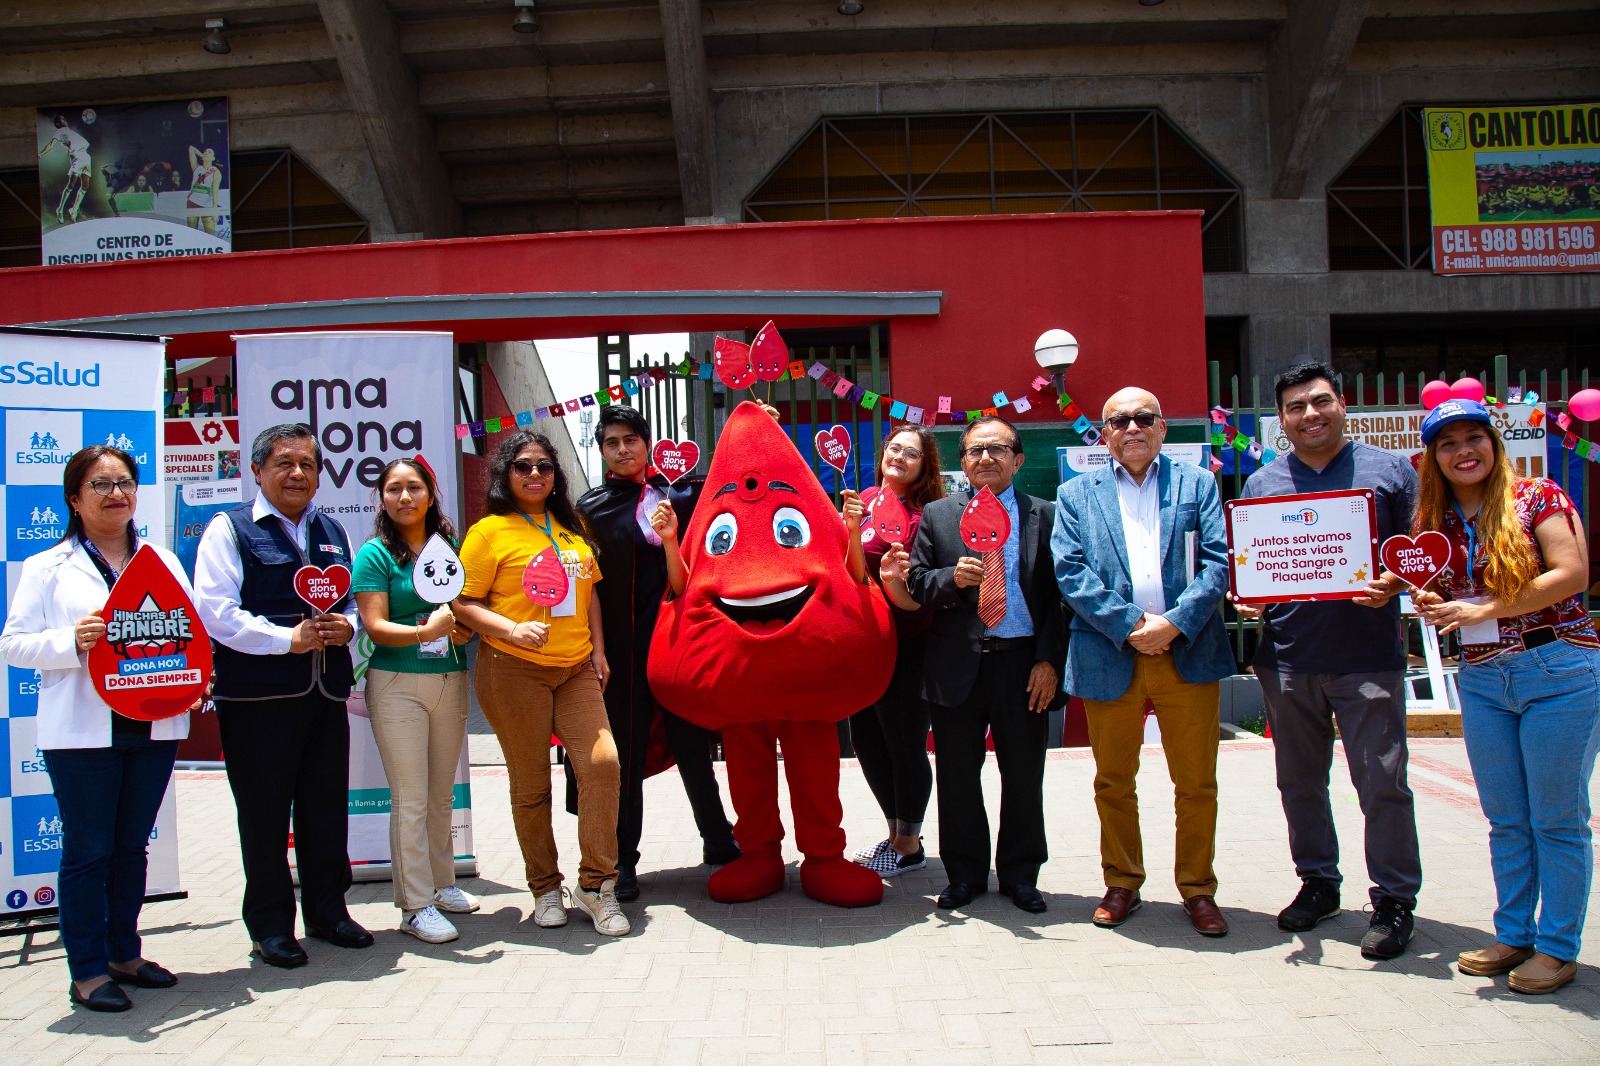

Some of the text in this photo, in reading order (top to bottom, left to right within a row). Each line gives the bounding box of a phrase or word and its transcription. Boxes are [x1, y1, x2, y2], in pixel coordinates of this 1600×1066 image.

[1468, 107, 1600, 148] CANTOLAO
[96, 233, 173, 250] CENTRO DE
[1441, 225, 1595, 254] CEL: 988 981 596
[48, 250, 134, 266] DISCIPLINAS
[1443, 255, 1484, 270] E-mail:
[0, 361, 100, 387] sSalud
[270, 377, 388, 411] ama
[1343, 415, 1405, 434] ERSIDAD
[1502, 428, 1546, 441] CEDID
[825, 438, 838, 448] ama
[828, 443, 844, 455] dona
[16, 451, 73, 465] EsSalud
[164, 453, 215, 463] CTIVIDADES
[662, 450, 681, 458] ama
[663, 457, 686, 465] dona
[828, 452, 842, 461] vive
[164, 464, 214, 474] SPECIALES
[661, 462, 679, 470] vive
[315, 503, 376, 514] das está en
[1282, 513, 1303, 522] insn
[16, 526, 65, 540] EsSalu
[1251, 531, 1352, 548] Juntos salvamos
[1258, 543, 1344, 559] muchas vidas
[1396, 547, 1424, 558] ama
[1256, 557, 1348, 572] Dona Sangre o
[1400, 554, 1433, 567] dona
[1398, 563, 1425, 574] vive
[307, 577, 330, 586] ama
[1271, 569, 1333, 584] Plaquetas
[307, 591, 330, 599] vive
[310, 584, 337, 593] dona
[113, 607, 186, 622] HINCHAS DE
[107, 618, 193, 642] SANGRE
[123, 658, 184, 673] DONA HOY,
[108, 672, 198, 688] DONA SIEMPRE
[354, 798, 376, 808] llama
[23, 835, 63, 853] EsSal
